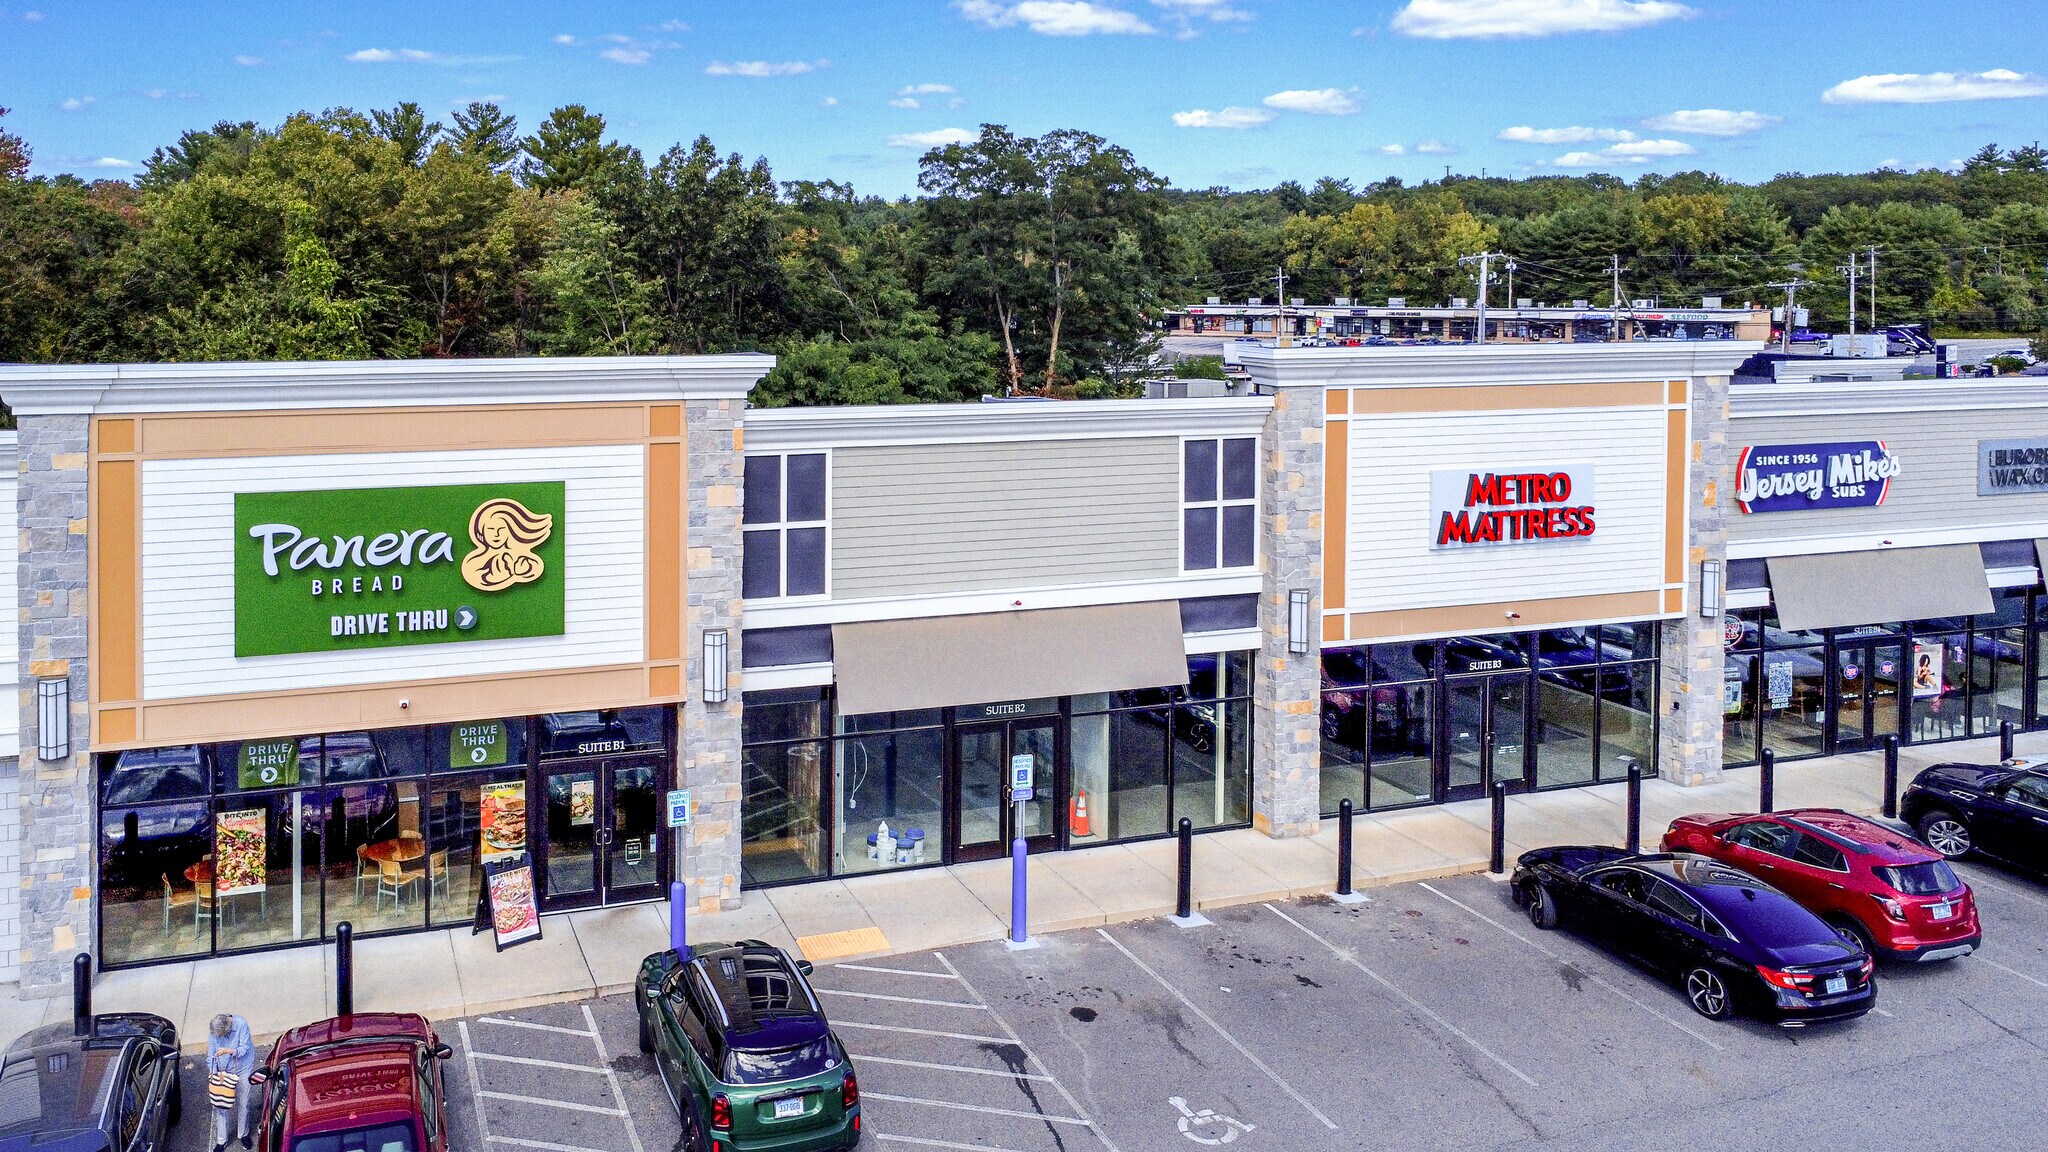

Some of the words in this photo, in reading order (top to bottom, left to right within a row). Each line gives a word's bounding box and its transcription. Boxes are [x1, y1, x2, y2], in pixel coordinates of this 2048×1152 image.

[1756, 455, 1790, 466] SINCE
[1792, 453, 1818, 465] 1956
[1736, 468, 1823, 502] Jersey
[1826, 450, 1901, 487] Mike's
[1989, 468, 2029, 487] WAX
[1464, 472, 1572, 507] METRO
[1831, 485, 1866, 498] SUBS
[1437, 506, 1596, 545] MATTRESS
[250, 523, 454, 576] Panera
[312, 575, 403, 595] BREAD
[331, 612, 389, 636] DRIVE
[396, 609, 448, 632] THRU
[1854, 625, 1873, 635] SUITE
[1469, 660, 1492, 670] SUITE
[1493, 659, 1502, 669] B3
[986, 704, 1014, 715] SUITE
[1015, 703, 1026, 713] B2
[460, 724, 497, 736] DRIVE
[462, 735, 495, 747] THRU
[578, 741, 612, 754] SUITE
[613, 740, 625, 751] B1
[248, 743, 289, 756] DRIVE
[250, 754, 286, 766] THRU
